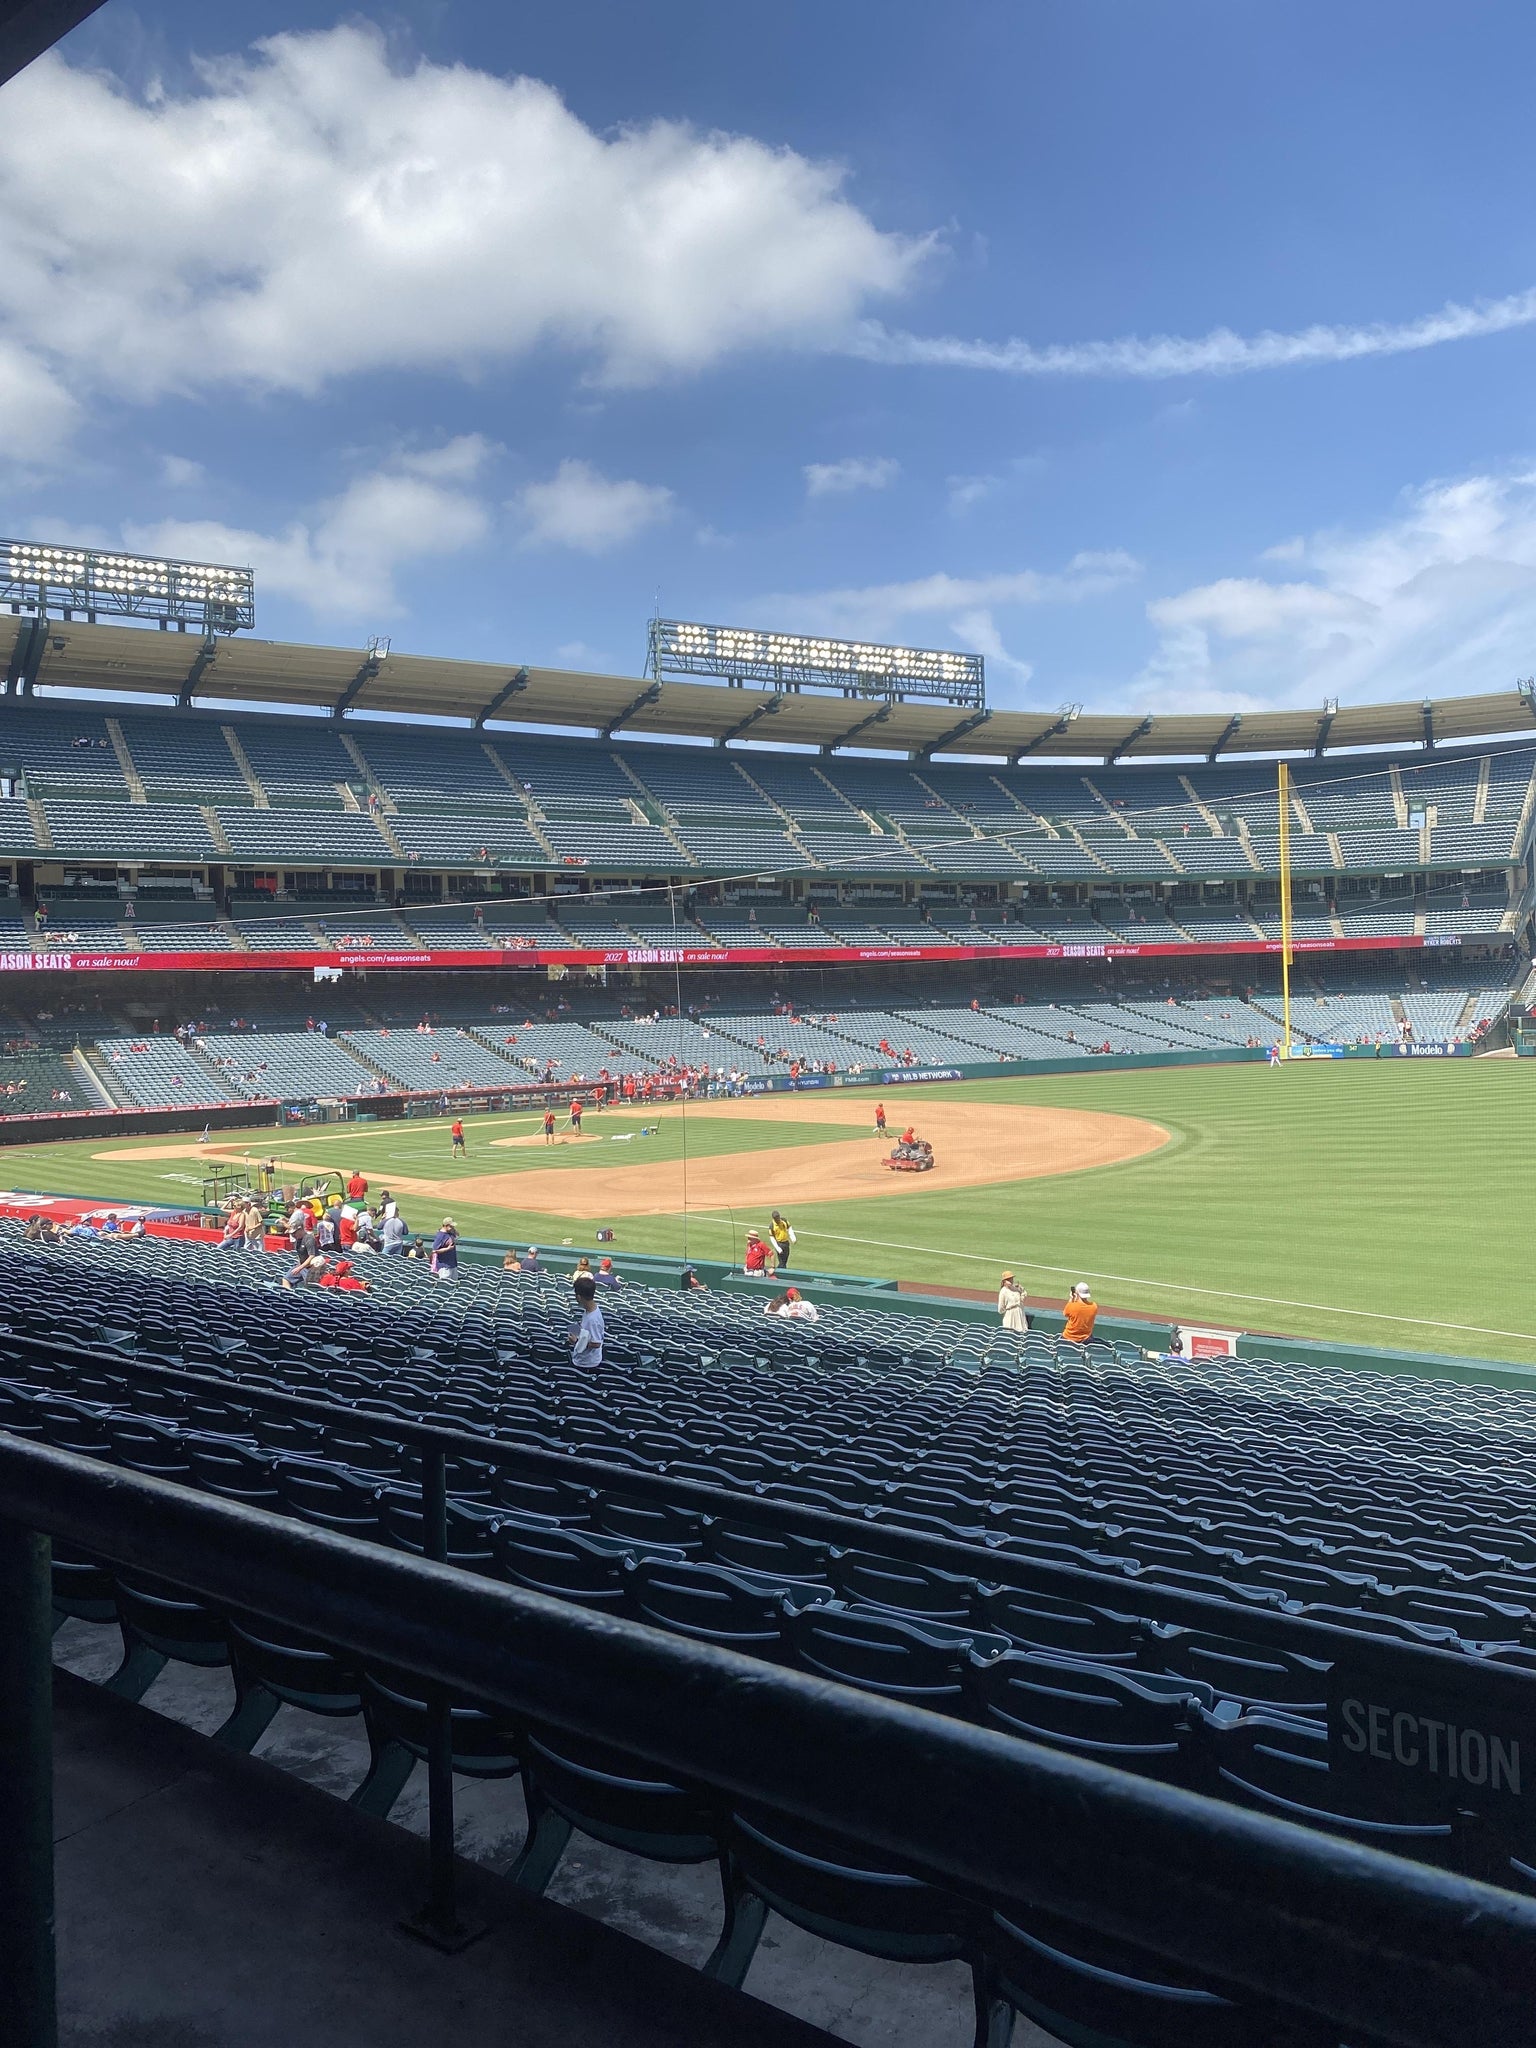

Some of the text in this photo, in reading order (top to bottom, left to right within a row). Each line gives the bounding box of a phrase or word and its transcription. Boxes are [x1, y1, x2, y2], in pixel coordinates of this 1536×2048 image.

[604, 953, 623, 962] 2027
[627, 950, 658, 963] SEASON
[660, 950, 684, 962] SEATS
[696, 952, 710, 960] sale
[711, 952, 728, 960] now!
[1063, 946, 1085, 956] SEASON
[1086, 946, 1105, 956] SEATS
[35, 954, 71, 969] SEATS
[91, 957, 112, 966] sale
[113, 956, 140, 966] now!
[340, 954, 431, 963] angels.com/seasonseats
[1411, 1044, 1443, 1055] Modelo
[902, 1070, 952, 1081] MLB NETWORK
[659, 1077, 678, 1086] INC.
[744, 1081, 765, 1090] Modelo
[184, 1212, 201, 1223] INC.
[1341, 1698, 1521, 1795] SECTION
